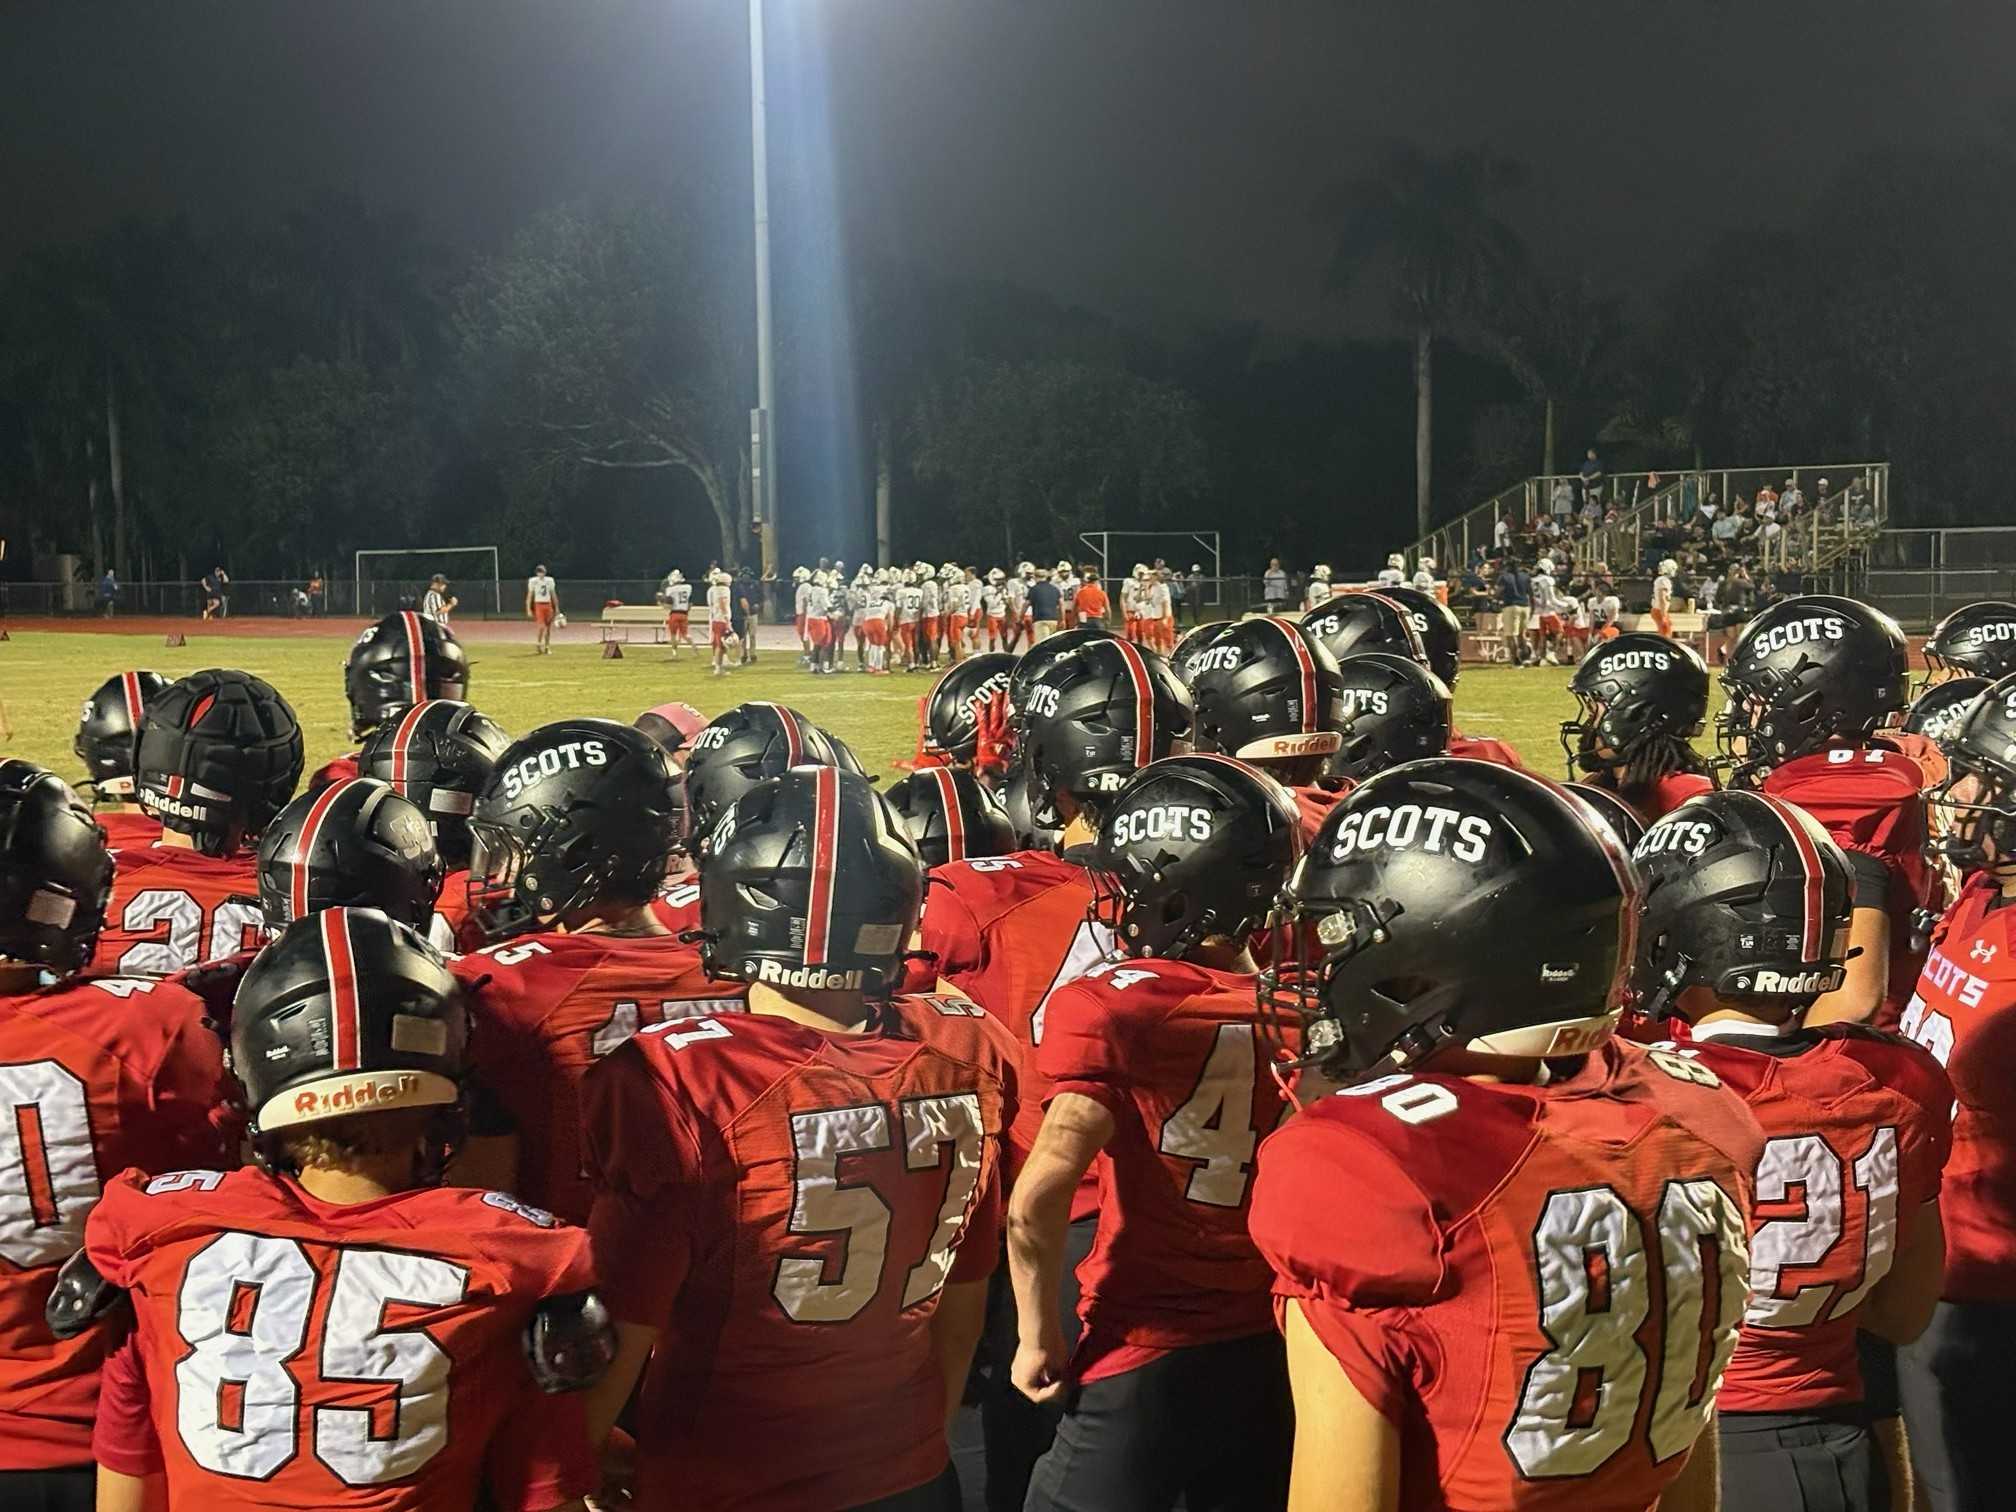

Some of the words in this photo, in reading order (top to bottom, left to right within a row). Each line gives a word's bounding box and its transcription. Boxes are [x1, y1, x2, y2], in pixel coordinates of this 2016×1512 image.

[907, 595, 920, 609] 30
[1754, 618, 1844, 659] SCOTS
[1600, 651, 1670, 676] SCOTS
[958, 672, 1011, 725] SCOTS
[1273, 736, 1337, 754] Riddell
[502, 740, 607, 800] SCOTS
[144, 788, 207, 821] Riddell
[1114, 806, 1212, 847] SCOTS
[1332, 804, 1491, 863] SCOTS
[1632, 821, 1711, 862] COTS
[759, 959, 863, 990] Riddell
[1754, 970, 1842, 993] Riddell
[1923, 943, 1990, 1009] COTS
[294, 1075, 419, 1114] Riddell
[1161, 1024, 1257, 1207] 4
[773, 1093, 985, 1322] 57
[1746, 1127, 1899, 1328] 21
[1503, 1178, 1750, 1481] 80
[176, 1230, 470, 1486] 85
